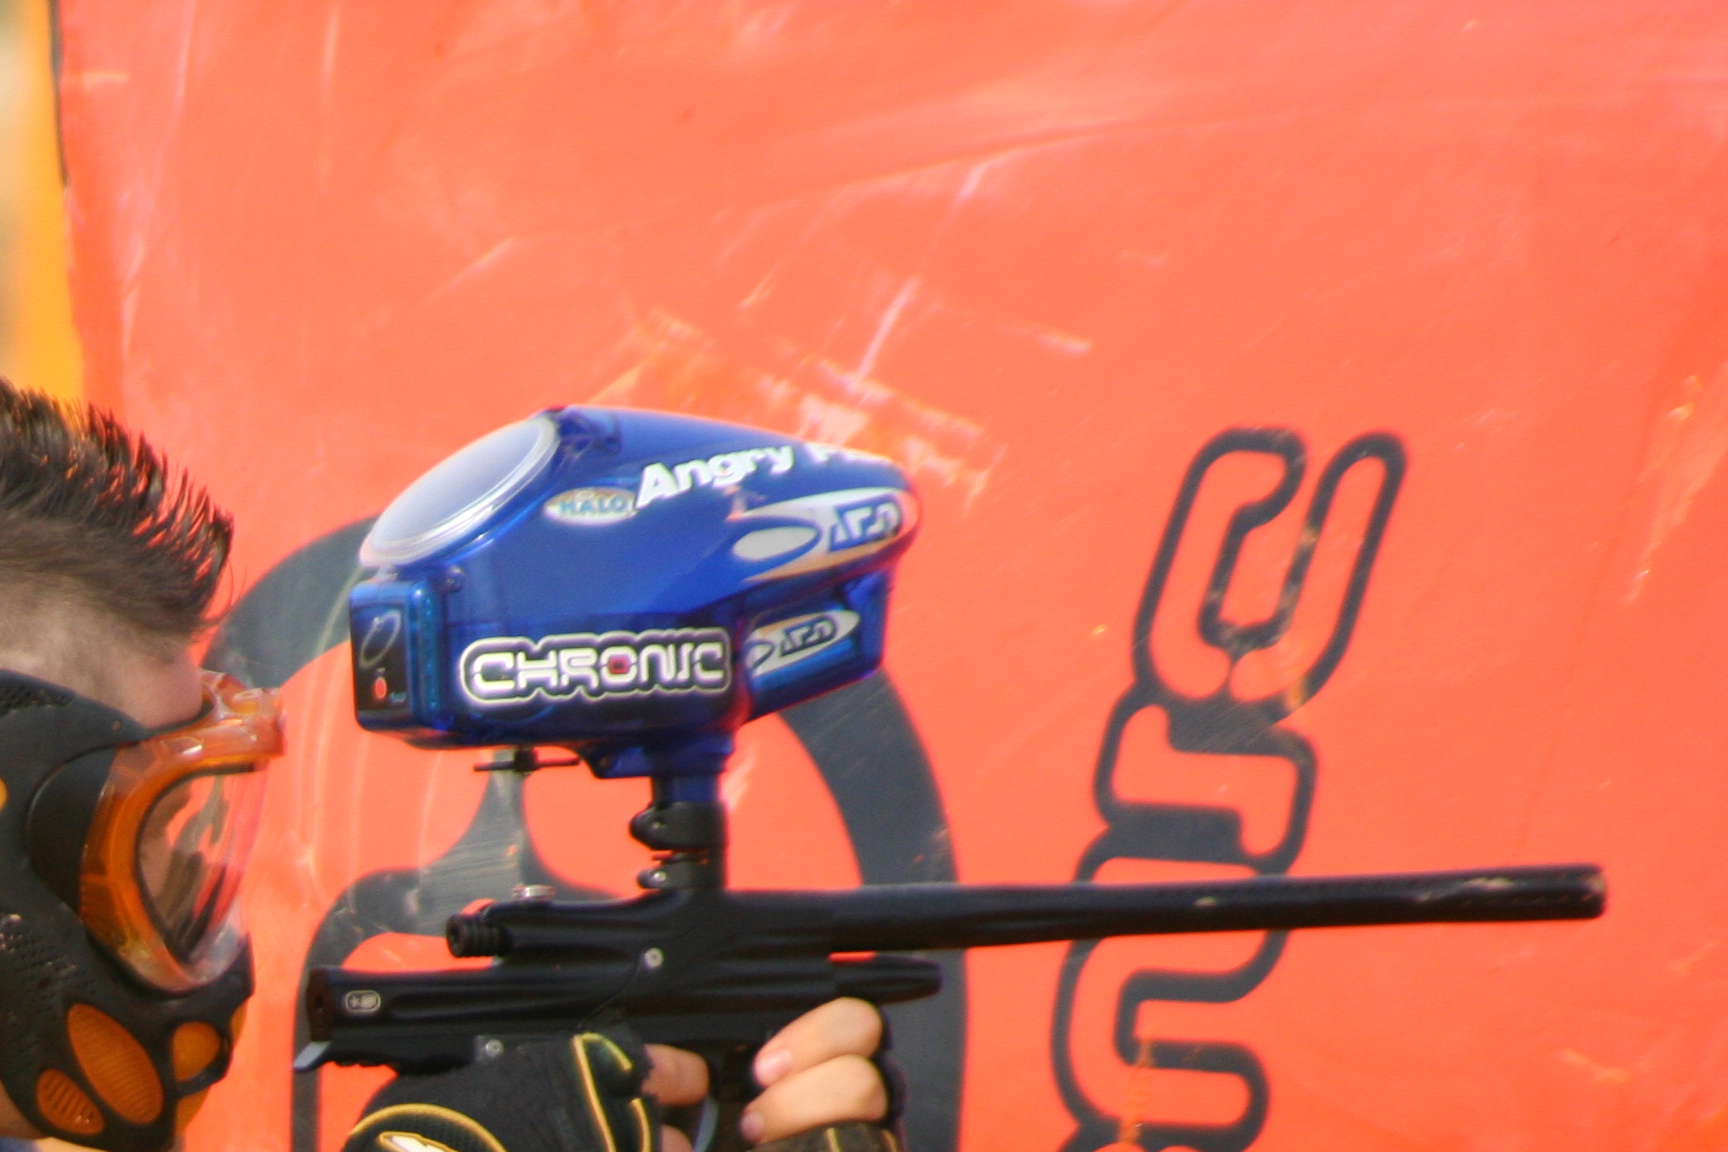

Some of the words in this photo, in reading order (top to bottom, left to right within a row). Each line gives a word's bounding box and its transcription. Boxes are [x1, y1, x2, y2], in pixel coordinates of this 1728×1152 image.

[558, 493, 628, 514] HALO
[635, 445, 794, 510] Angry
[468, 636, 727, 695] CHRONIC
